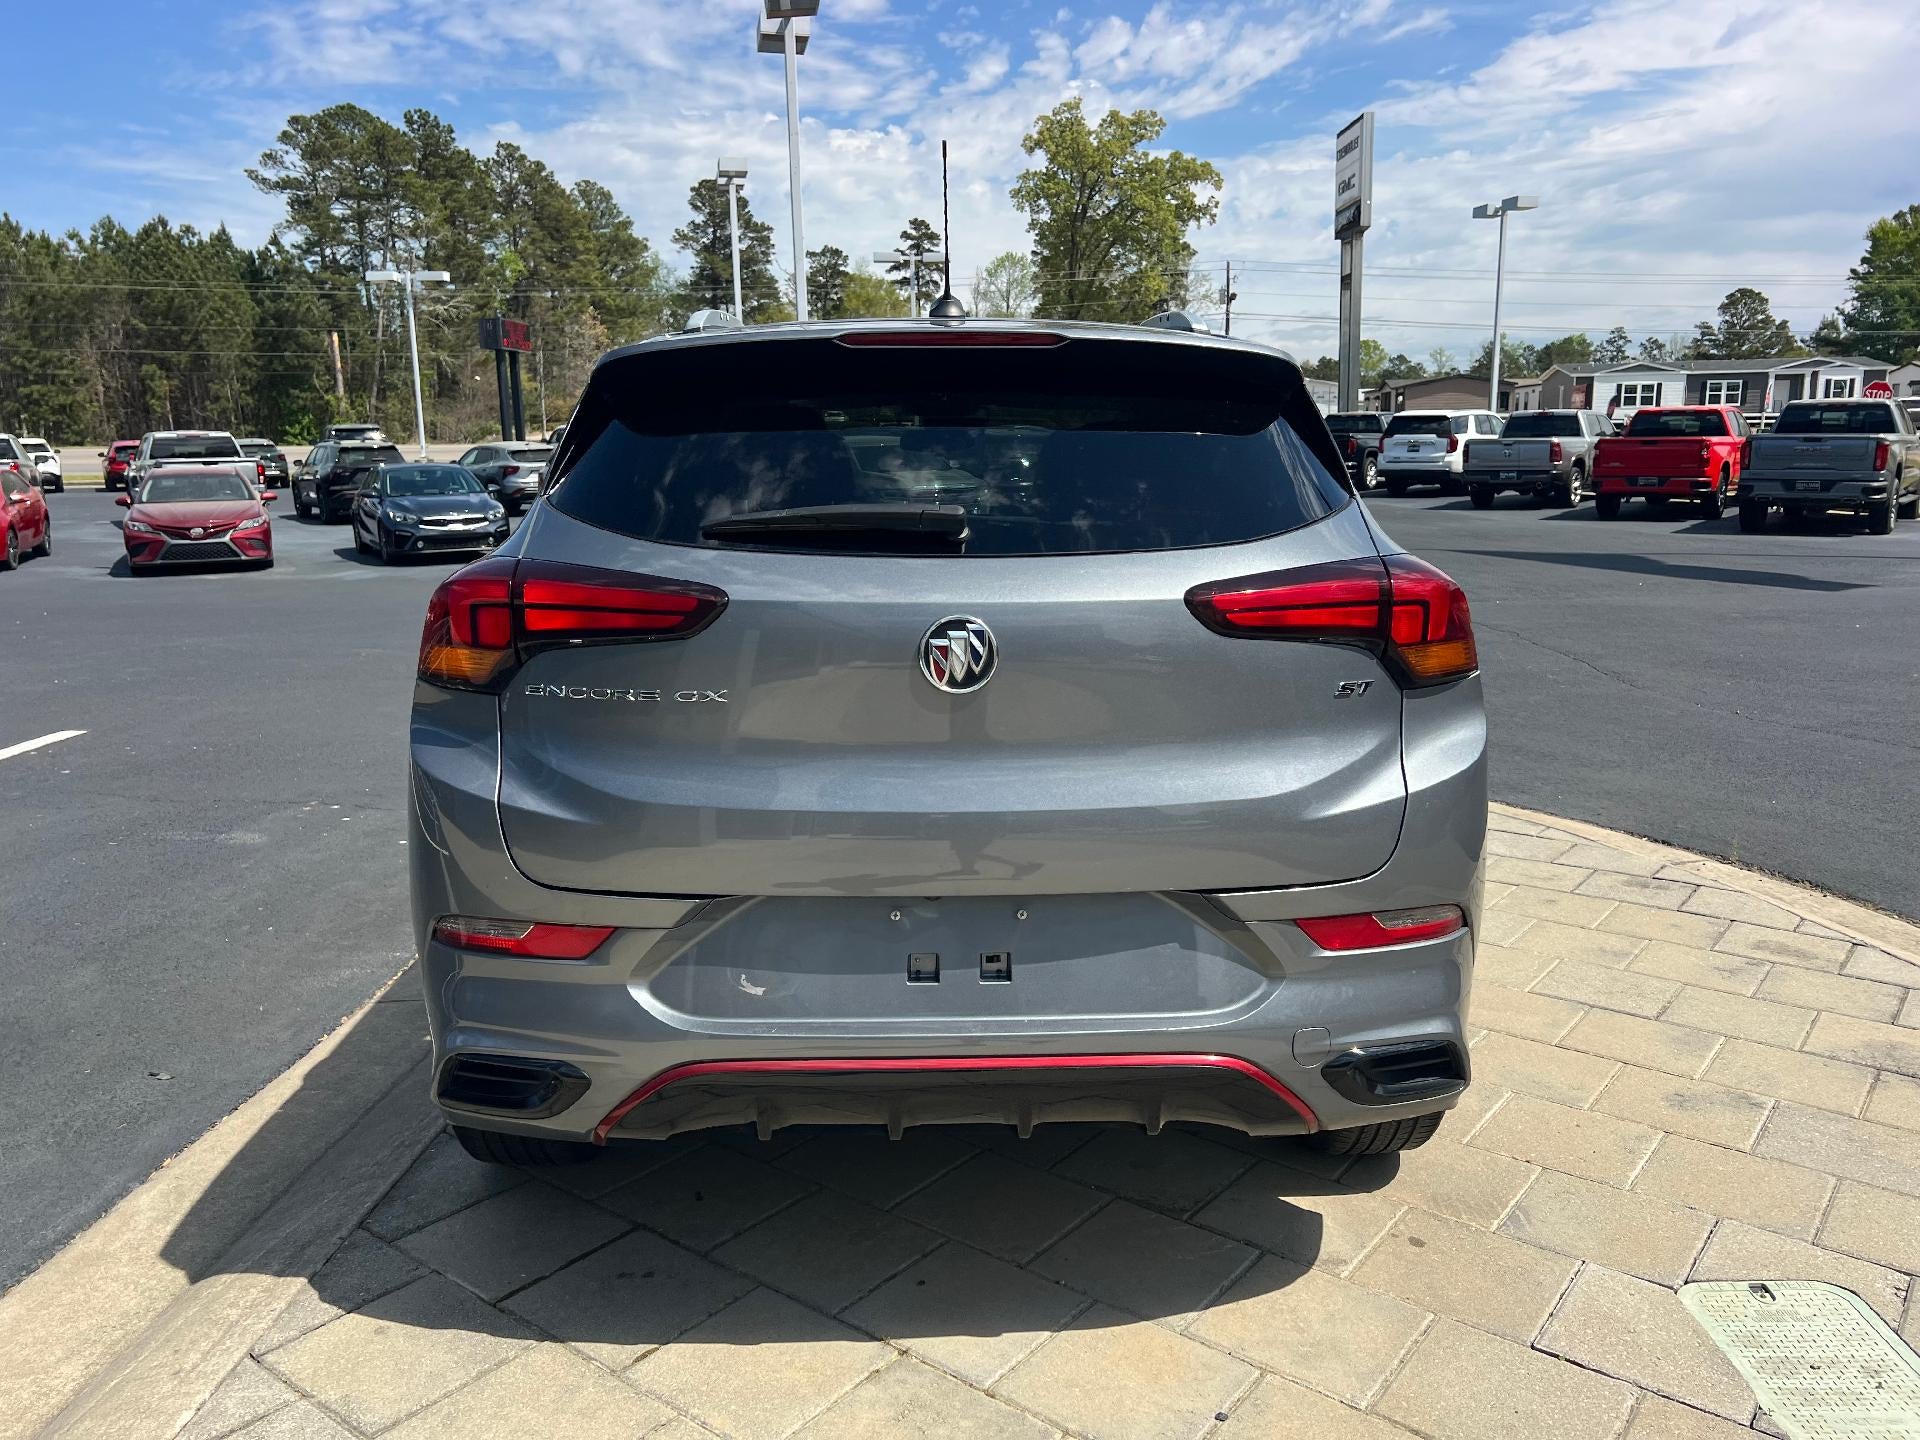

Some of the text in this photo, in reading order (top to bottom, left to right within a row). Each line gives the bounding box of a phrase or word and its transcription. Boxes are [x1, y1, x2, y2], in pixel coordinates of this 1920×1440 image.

[1865, 389, 1891, 399] STOP
[524, 683, 729, 703] ENCORE GX
[1333, 679, 1375, 698] ST
[1774, 1281, 1816, 1291] HERE
